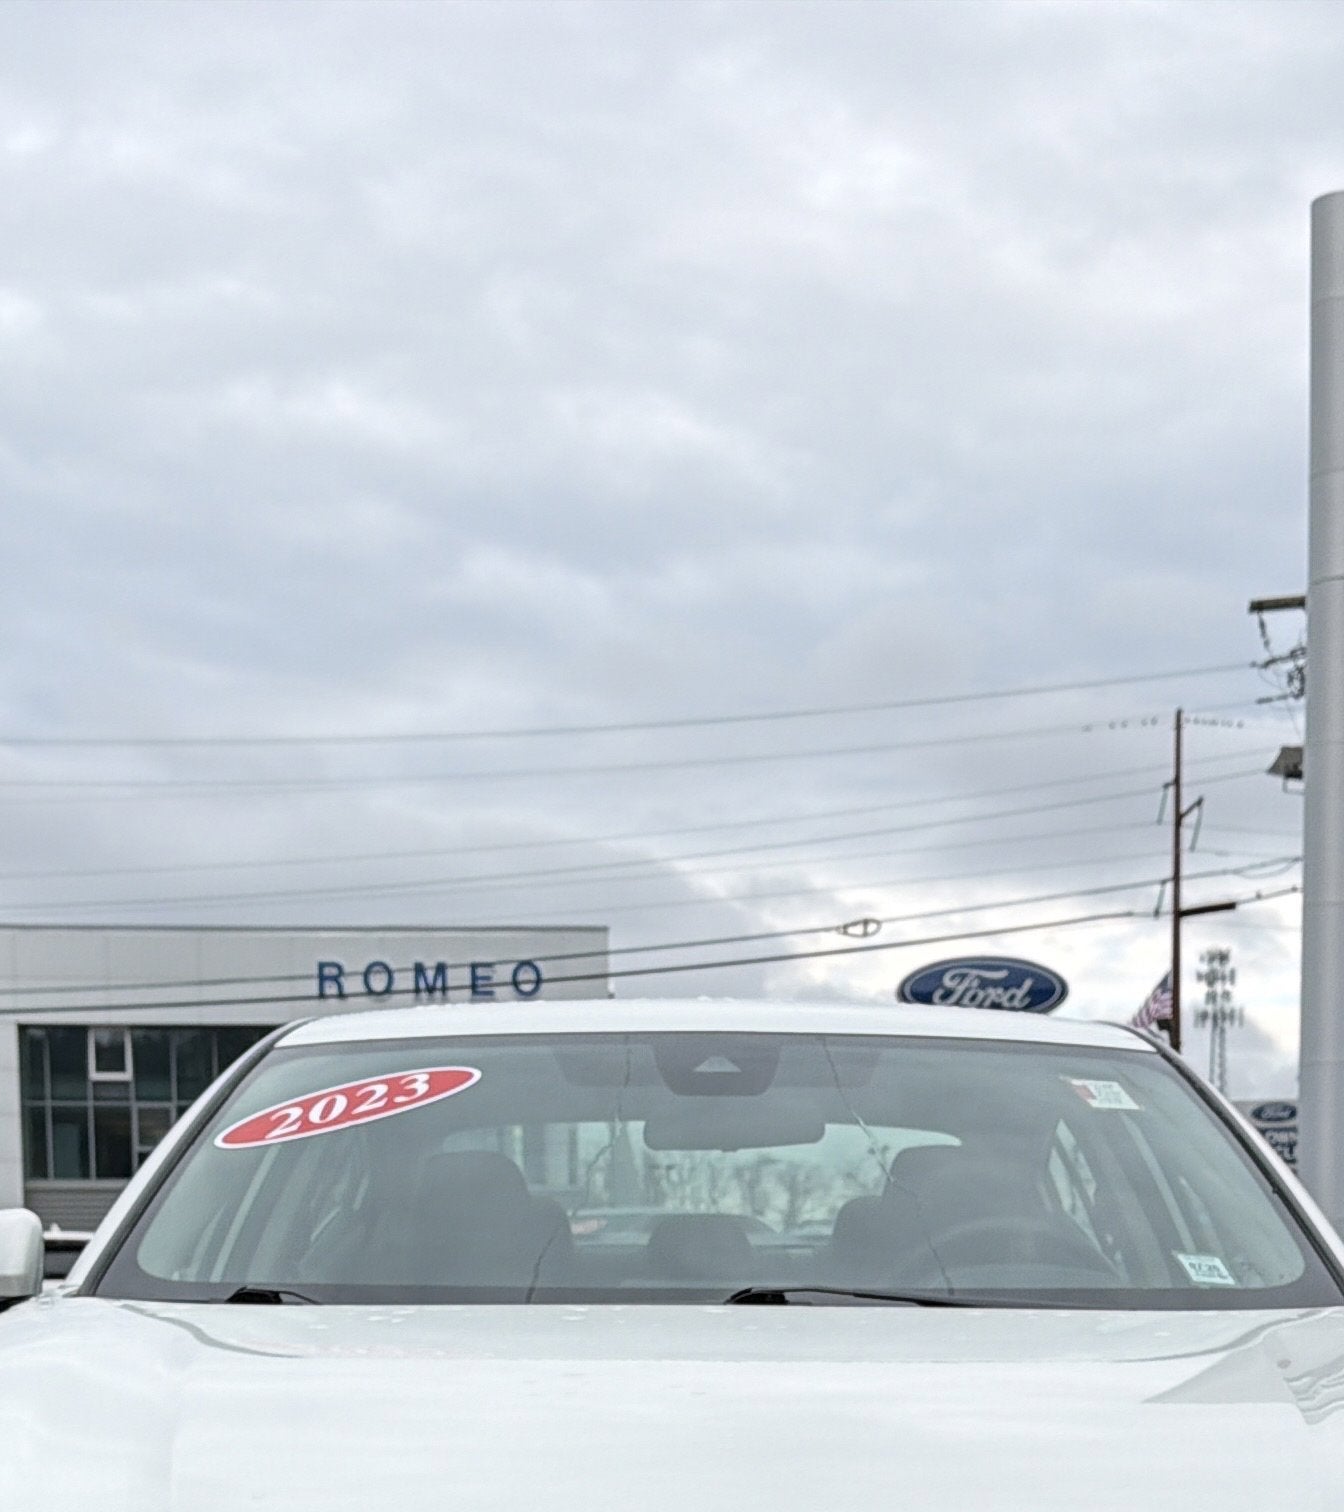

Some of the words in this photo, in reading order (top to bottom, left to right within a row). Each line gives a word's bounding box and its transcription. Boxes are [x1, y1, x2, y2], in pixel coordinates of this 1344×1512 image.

[317, 960, 541, 998] ROMEO
[932, 967, 1034, 1008] Ford
[265, 1072, 430, 1139] 2023
